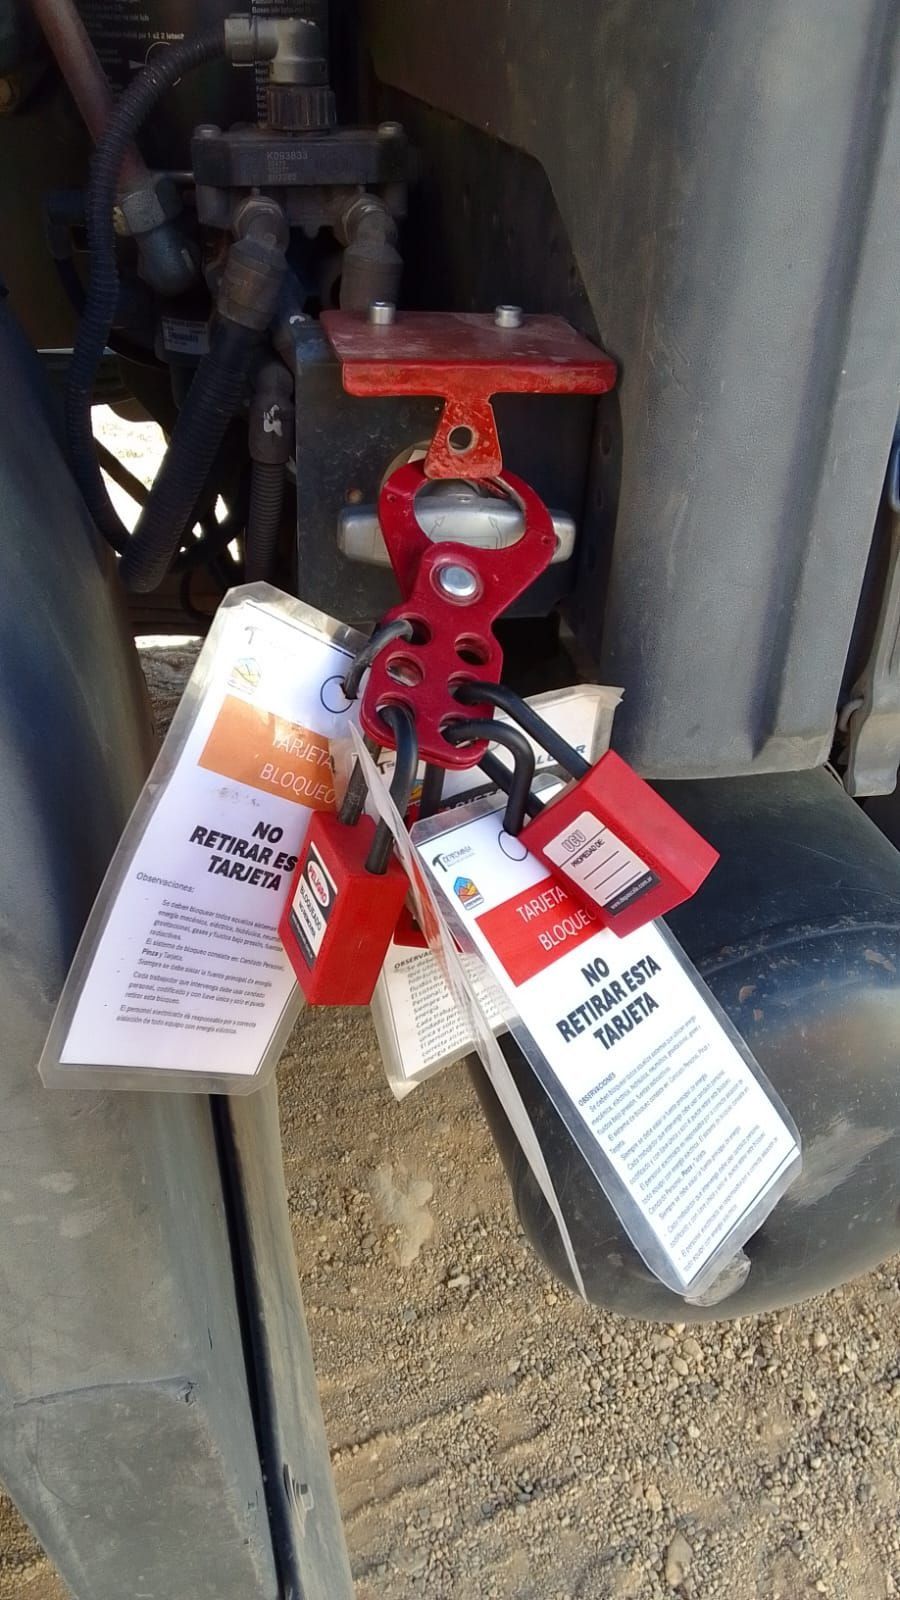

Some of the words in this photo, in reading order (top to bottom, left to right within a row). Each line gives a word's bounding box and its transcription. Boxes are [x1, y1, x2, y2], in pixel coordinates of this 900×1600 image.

[272, 734, 332, 769] TARJETA
[259, 763, 336, 804] BLOQUEO
[189, 825, 273, 869] RETIRAR
[273, 852, 299, 872] ES
[252, 821, 284, 844] NO
[207, 855, 283, 892] TARJETA
[516, 886, 568, 922] TARJETA
[580, 957, 610, 987] NO
[556, 980, 627, 1043] RETIRAR
[621, 955, 661, 1002] ESTA
[593, 991, 659, 1050] TARJETA
